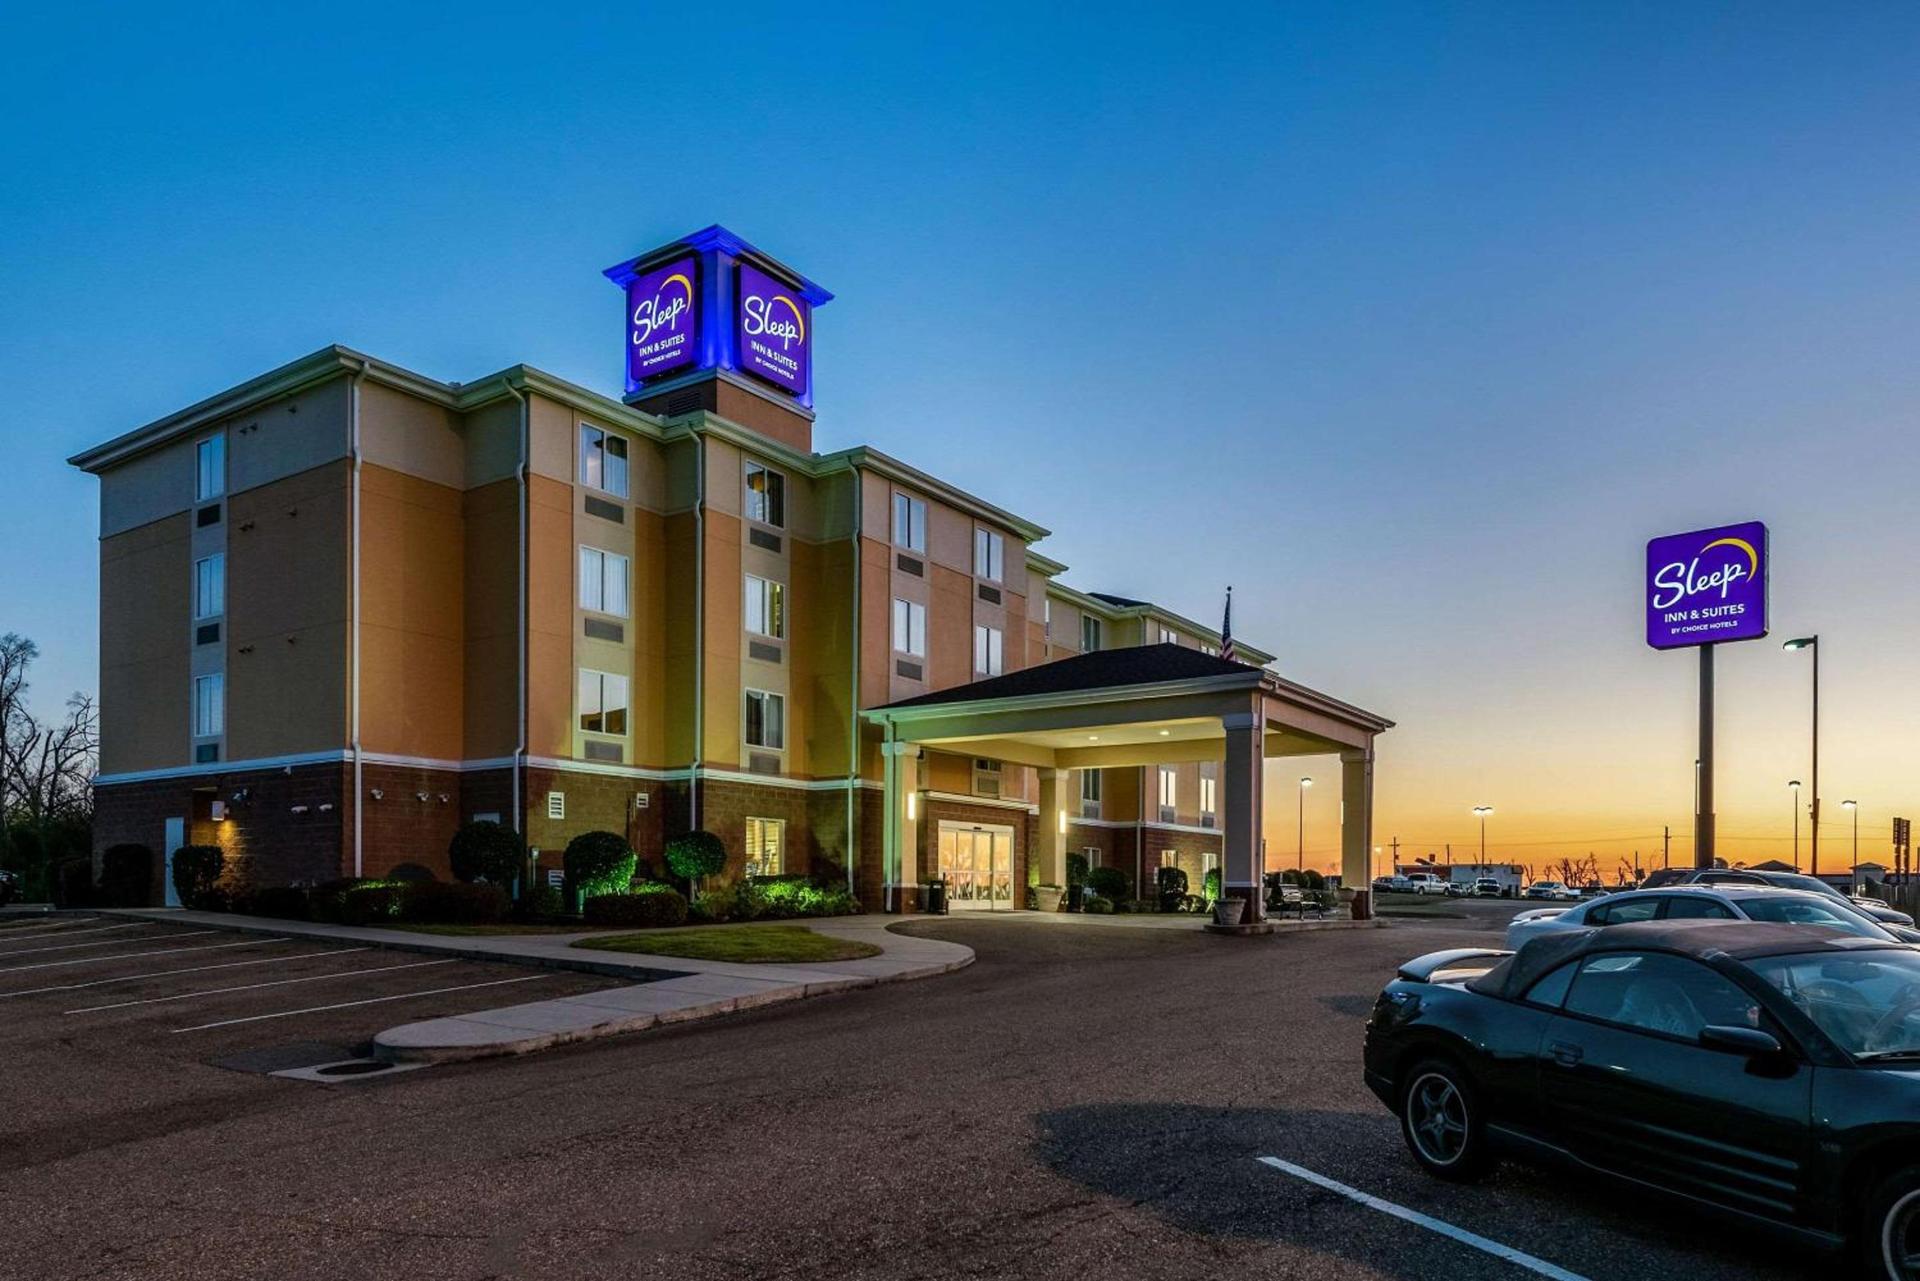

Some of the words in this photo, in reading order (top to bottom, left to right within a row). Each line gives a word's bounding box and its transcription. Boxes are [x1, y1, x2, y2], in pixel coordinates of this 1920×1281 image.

[633, 294, 686, 344] Sleep
[744, 295, 799, 350] Sleep
[639, 345, 653, 358] INN
[654, 342, 660, 352] &
[660, 333, 686, 350] SUITES
[751, 340, 766, 355] INN
[766, 348, 773, 358] &
[773, 352, 798, 371] SUITES
[1653, 557, 1746, 609] Sleep
[1664, 611, 1687, 623] INN
[1690, 609, 1700, 619] &
[1702, 604, 1745, 618] SUITES
[1681, 624, 1708, 633] CHOICE
[1709, 620, 1738, 629] HOTELS
